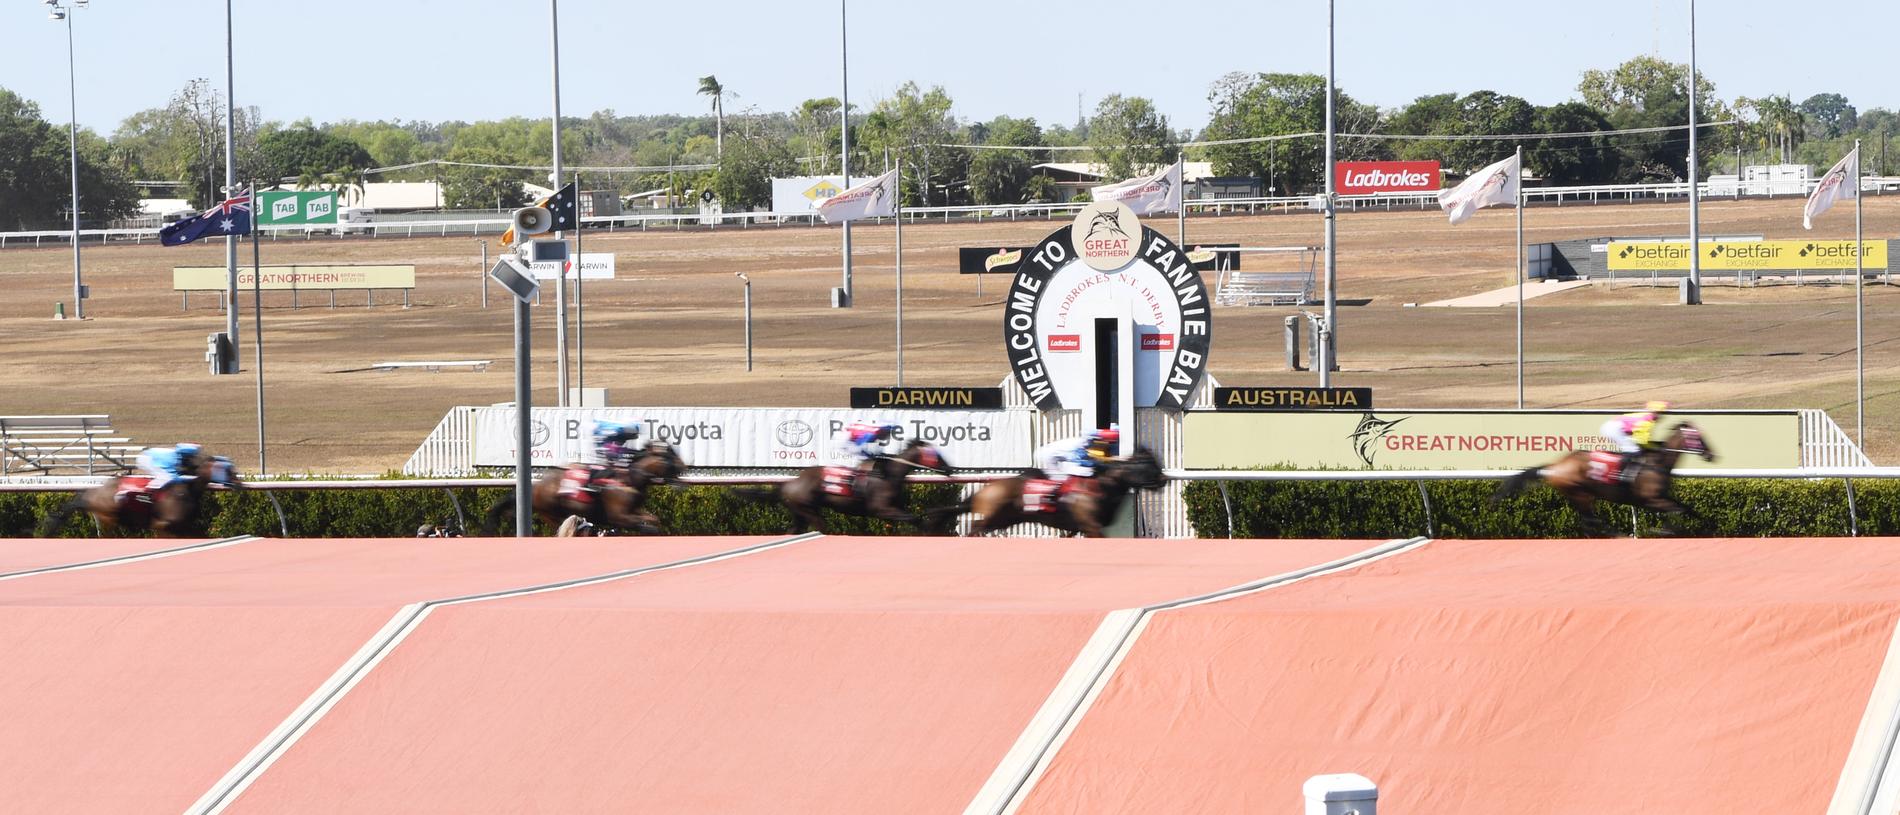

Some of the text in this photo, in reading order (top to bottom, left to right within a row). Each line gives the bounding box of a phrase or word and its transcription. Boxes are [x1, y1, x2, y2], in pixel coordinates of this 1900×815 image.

[1344, 169, 1430, 187] Ladbrokes
[705, 192, 710, 200] 9
[275, 203, 295, 212] TAB
[309, 203, 329, 212] TAB
[1085, 238, 1129, 250] GREAT
[1085, 249, 1130, 258] NORTHERN
[1635, 245, 1690, 258] betfair
[1726, 244, 1782, 258] betfair
[1726, 259, 1769, 267] EXCHANGE
[1816, 258, 1857, 266] EXCHANG
[278, 273, 339, 283] NORTHERN
[1057, 272, 1110, 329] LADBROKES
[1140, 287, 1166, 328] DERBY
[1010, 236, 1206, 406] WELCOME TO FANNIE BAY
[1050, 337, 1078, 347] Ladbrokes
[1143, 337, 1171, 346] Ladbrokes
[878, 390, 973, 405] DARWIN
[1227, 390, 1358, 406] AUSTRALIA
[644, 419, 722, 446] Toyota
[910, 419, 991, 447] Toyota
[1385, 435, 1573, 452] GREAT NORTHERN
[1577, 436, 1616, 444] BREWIN
[511, 450, 553, 459] TOTA
[773, 450, 817, 460] TOYOTA
